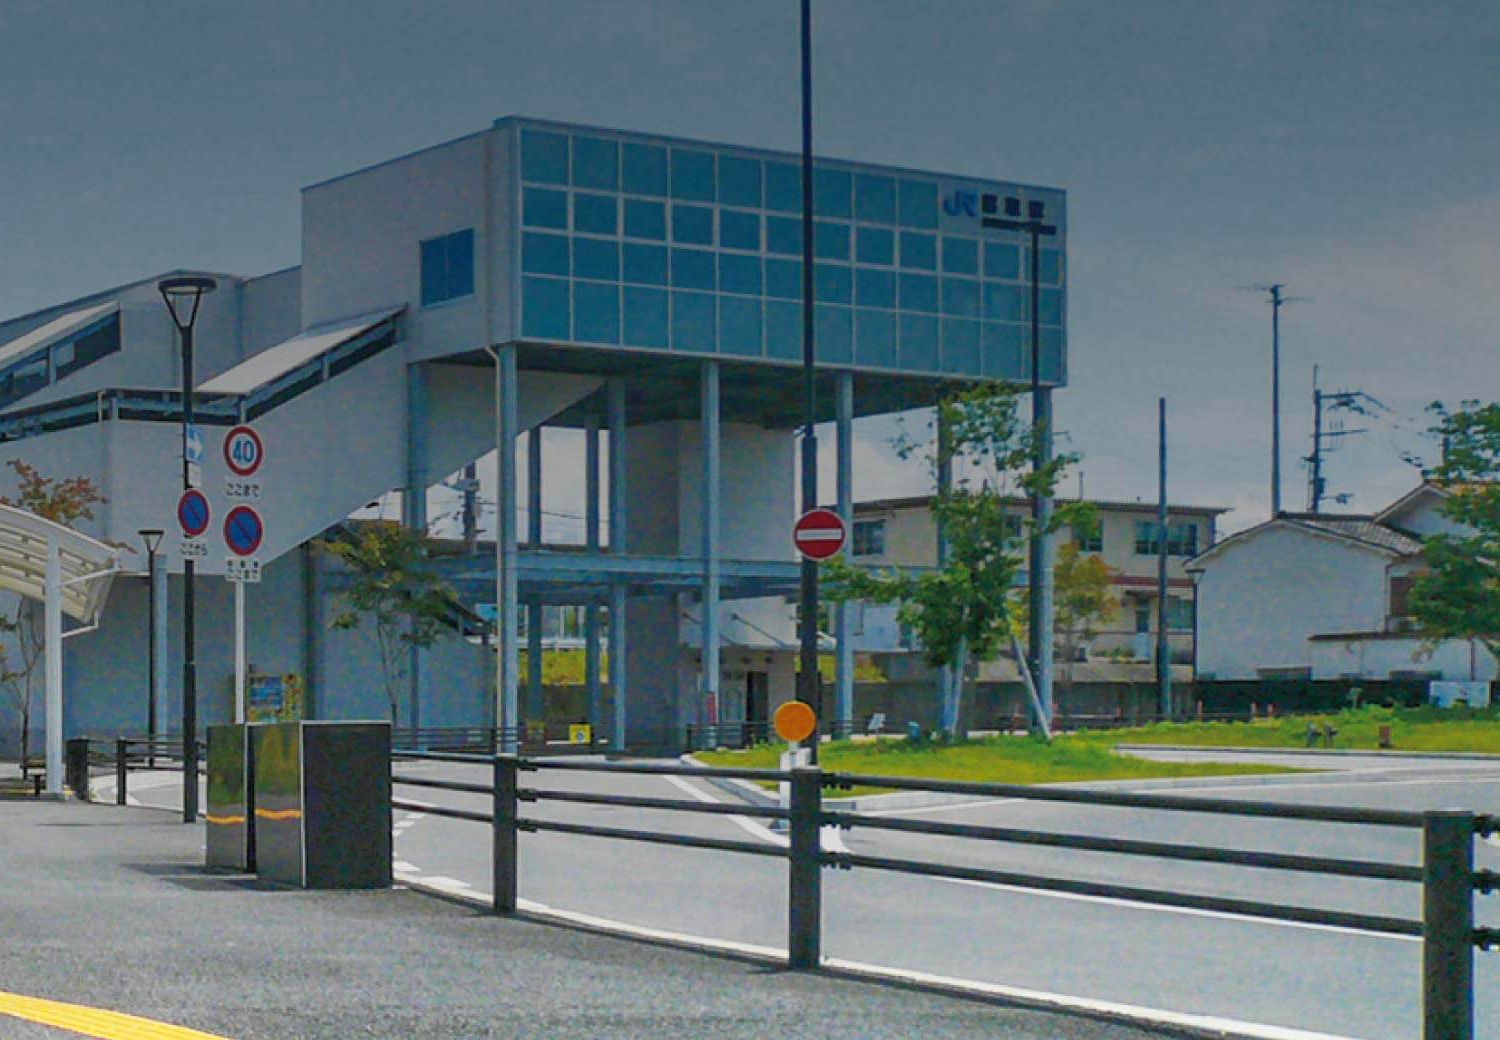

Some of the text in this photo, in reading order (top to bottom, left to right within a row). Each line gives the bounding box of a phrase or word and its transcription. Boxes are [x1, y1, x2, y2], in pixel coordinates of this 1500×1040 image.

[943, 189, 977, 217] JR
[233, 441, 255, 462] 40
[226, 483, 259, 497] ここまで
